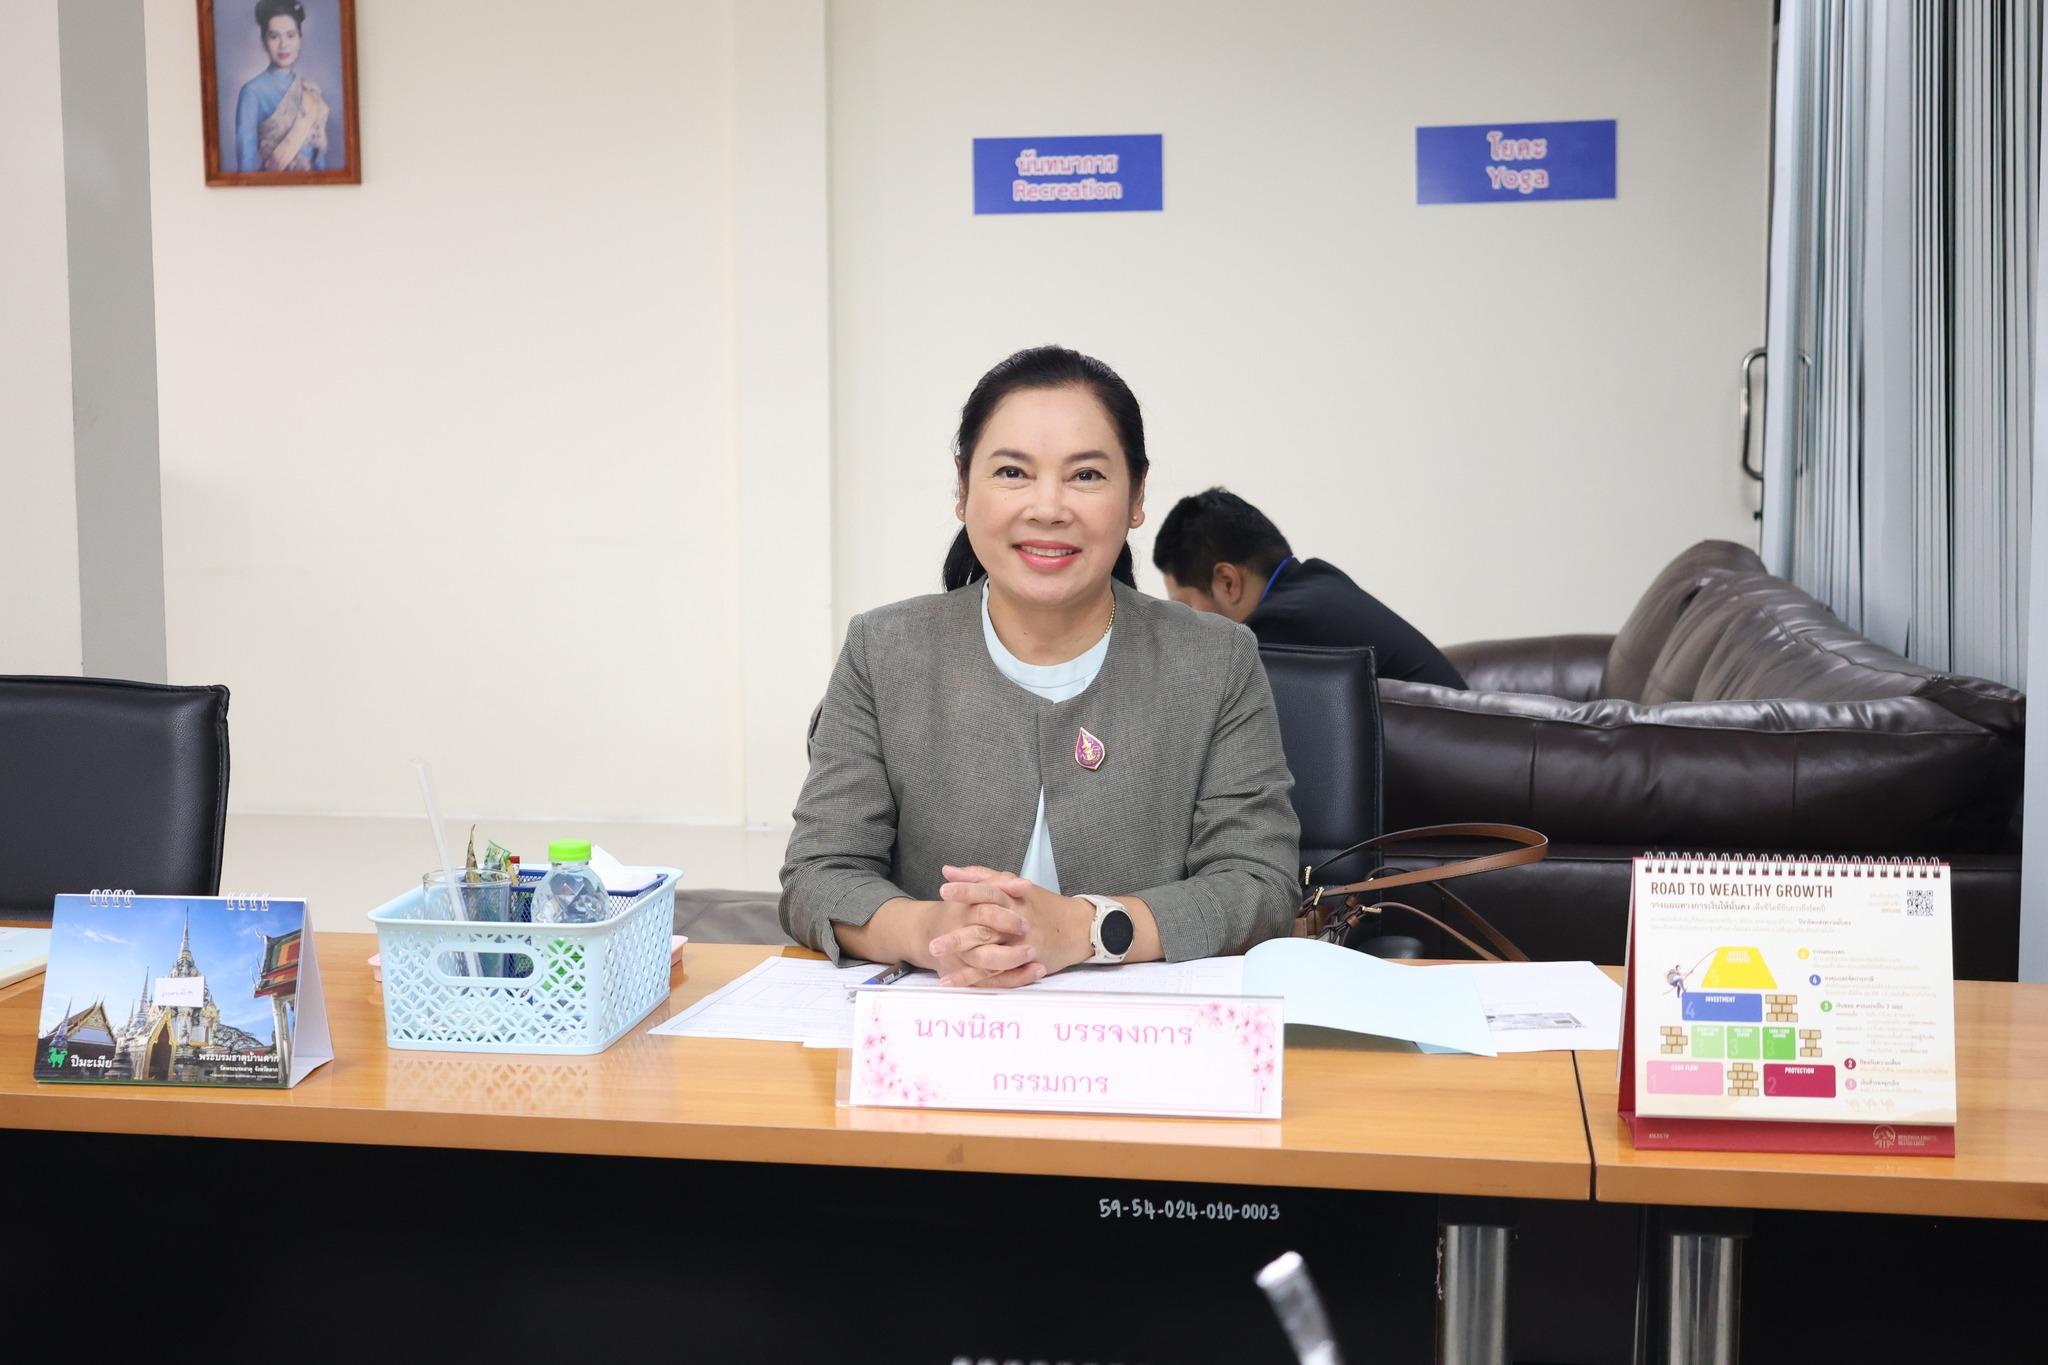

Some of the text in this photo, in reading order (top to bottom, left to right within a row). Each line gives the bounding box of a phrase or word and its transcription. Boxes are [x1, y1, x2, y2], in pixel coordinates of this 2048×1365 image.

[1487, 131, 1547, 161] โยคะ
[1016, 149, 1119, 176] นันทนาการ
[1013, 178, 1122, 202] Recreation
[1486, 166, 1549, 194] Yoga
[1651, 882, 1833, 898] ROAD TO WEALTHY GROWTH
[1685, 1001, 1696, 1018] 4
[915, 1013, 1193, 1046] นางนิสา บรรจงการ
[70, 1054, 113, 1068] ปีมะเมีย
[199, 1052, 280, 1065] พระบรมธาตุบ้านตาก
[992, 1072, 1109, 1095] กรรมการ
[1767, 1076, 1777, 1094] 2
[1099, 1198, 1280, 1220] 59-54-024-010-0003
